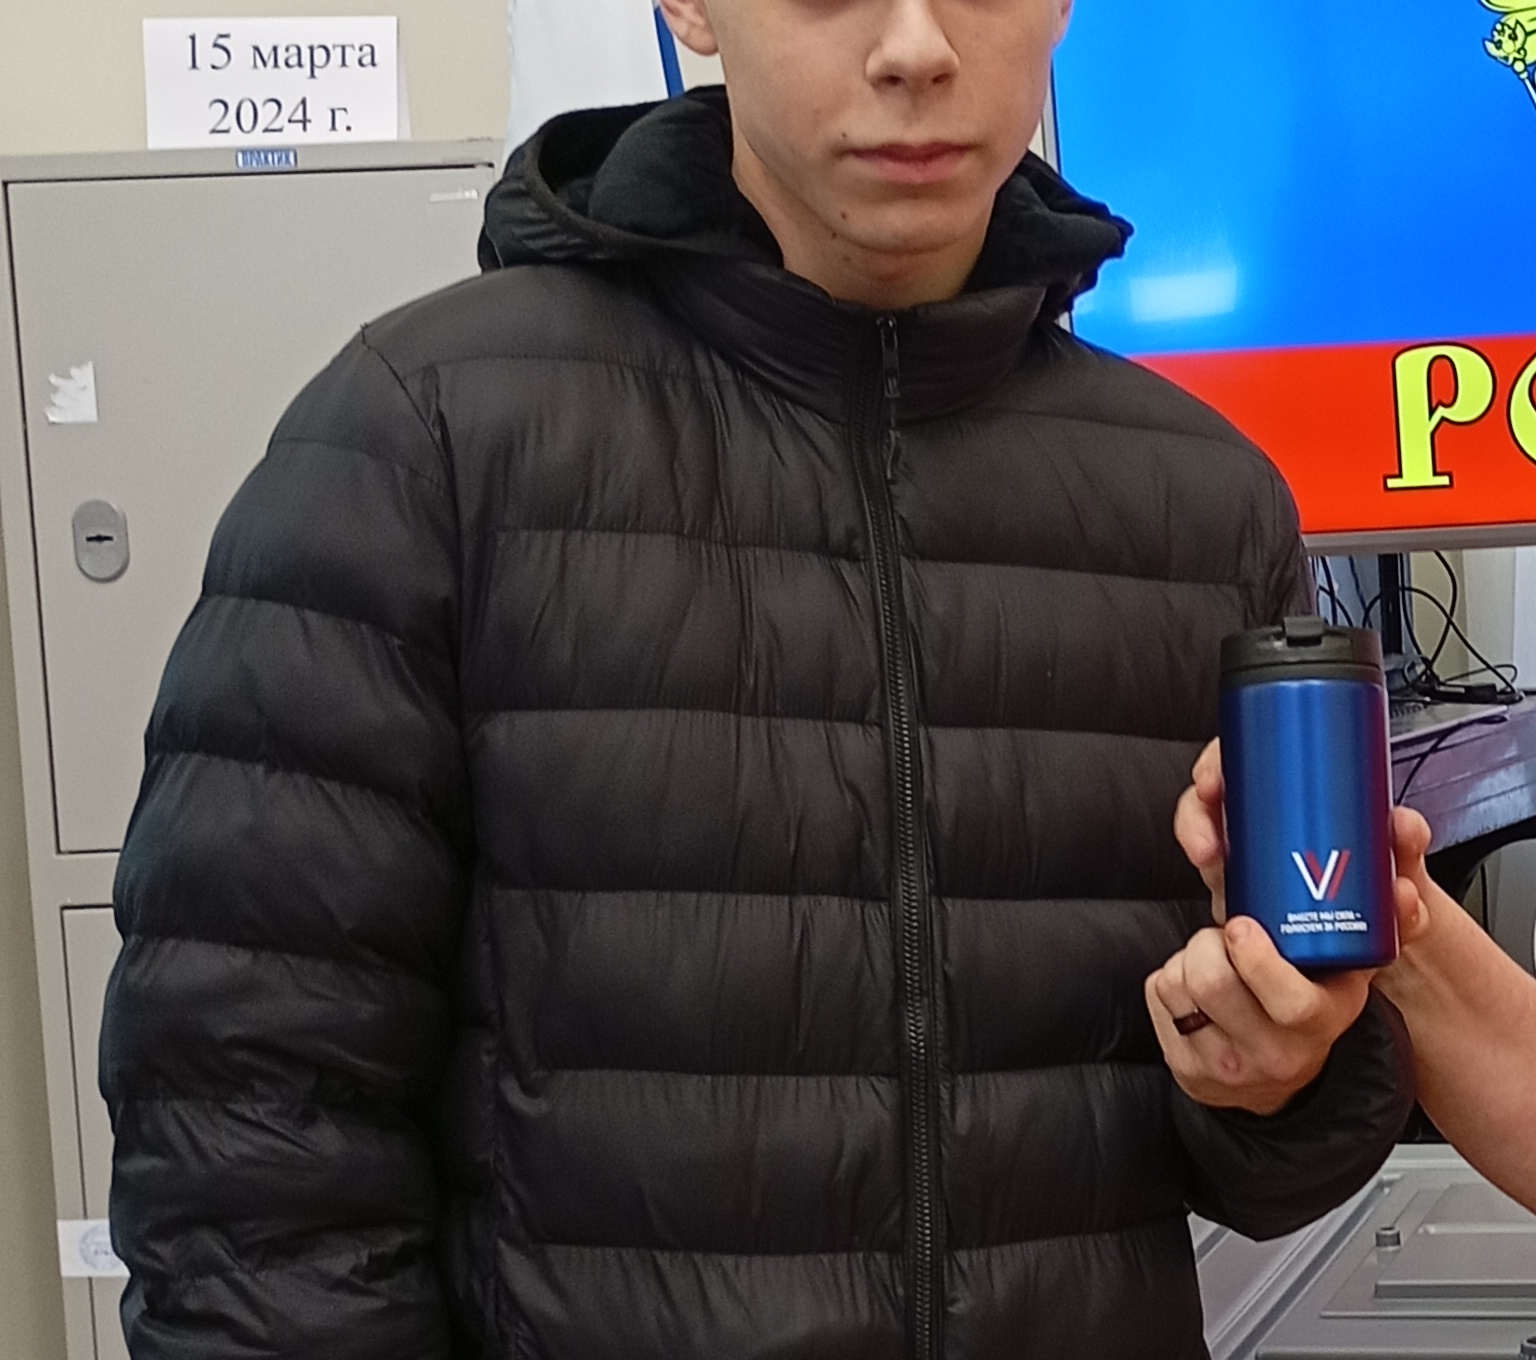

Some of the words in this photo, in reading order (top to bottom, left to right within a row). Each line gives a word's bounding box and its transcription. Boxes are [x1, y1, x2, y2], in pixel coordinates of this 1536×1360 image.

[187, 33, 233, 70] 15
[251, 41, 378, 79] марта
[208, 96, 312, 134] 2024
[328, 106, 352, 132] г.
